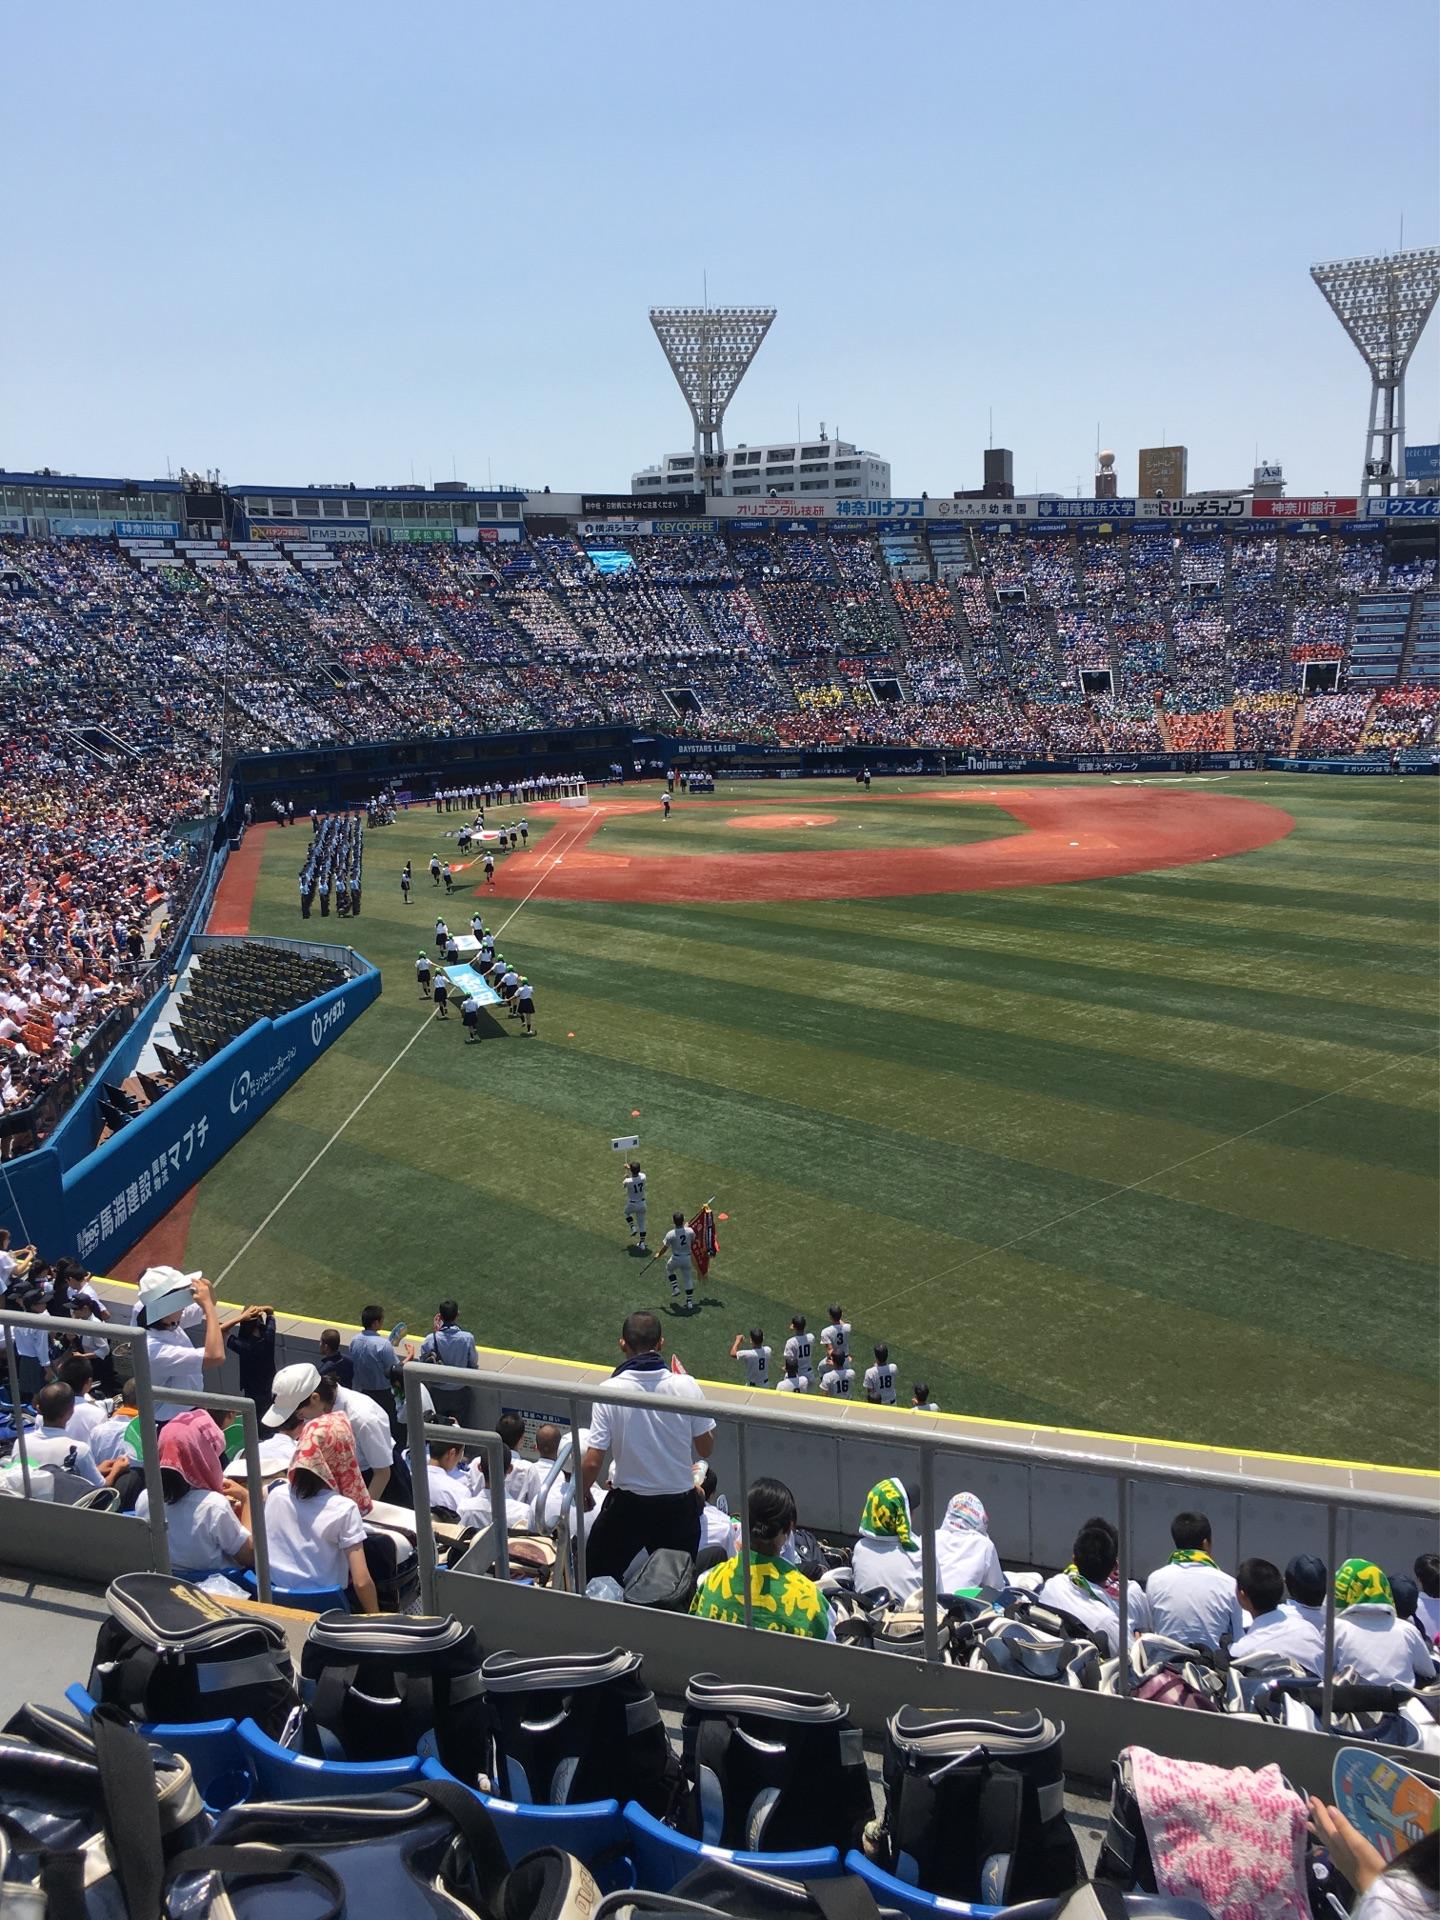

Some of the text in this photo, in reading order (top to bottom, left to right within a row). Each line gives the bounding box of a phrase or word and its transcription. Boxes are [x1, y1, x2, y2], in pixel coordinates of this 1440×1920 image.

[736, 505, 825, 516] オリエンタル技研
[988, 503, 1027, 515] 幼稚園
[1056, 502, 1134, 516] 桐蔭横浜大学
[1172, 501, 1245, 516] リッチライフ
[1271, 501, 1337, 515] 神奈川銀行
[120, 523, 174, 535] 神奈川新聞
[312, 530, 366, 538] FMヨコハマ
[595, 523, 640, 533] 横浜シミズ
[656, 522, 714, 532] KEY COFFEE
[678, 744, 737, 753] BAYSTARS LAGER
[967, 756, 1004, 771] Nojima
[168, 1115, 209, 1171] マブチ
[633, 1182, 644, 1194] 17
[679, 1234, 687, 1246] 2
[836, 1332, 844, 1346] 3
[798, 1344, 811, 1359] 10
[758, 1357, 766, 1371] 8
[836, 1379, 850, 1394] 16
[879, 1375, 892, 1390] 18
